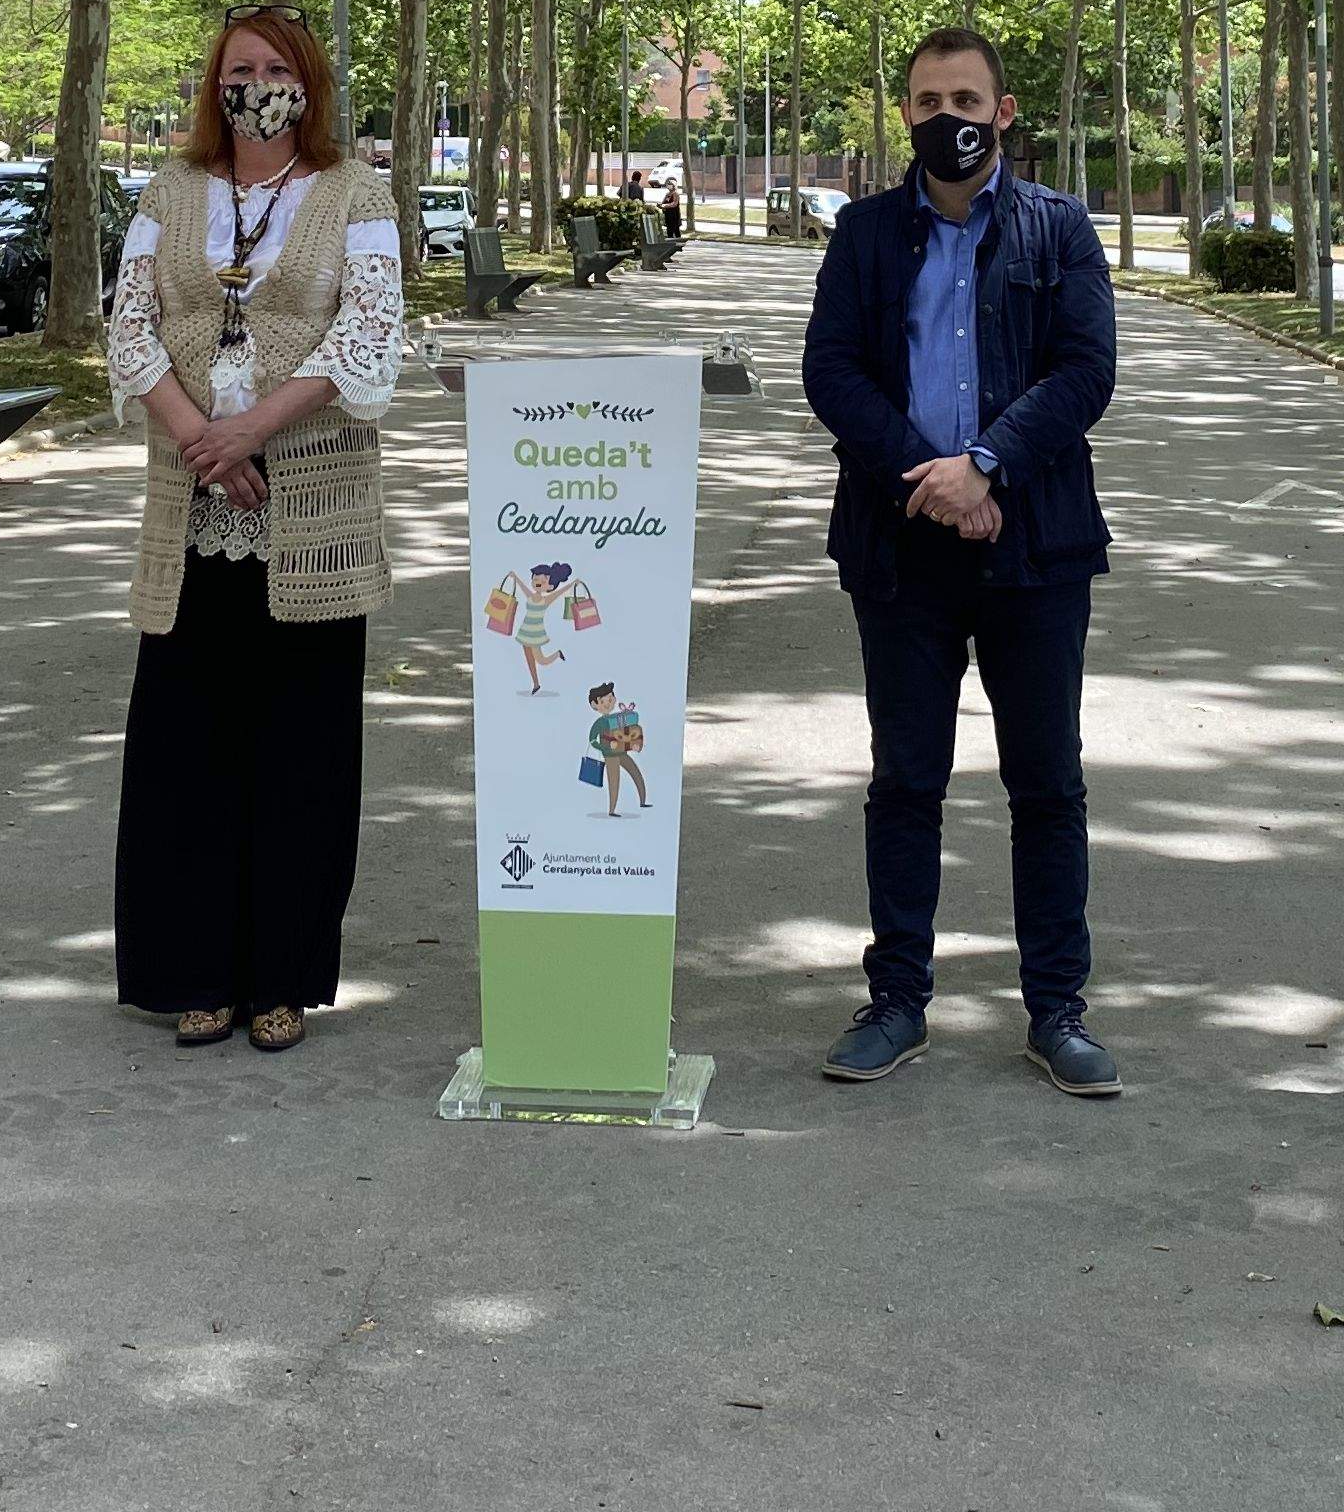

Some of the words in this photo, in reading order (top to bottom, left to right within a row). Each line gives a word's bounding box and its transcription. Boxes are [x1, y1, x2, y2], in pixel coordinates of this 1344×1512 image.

[513, 438, 652, 468] Queda't
[546, 474, 618, 500] amb
[497, 501, 667, 549] Cerdanyola
[542, 852, 601, 864] Ajuntament
[603, 854, 617, 864] de
[542, 864, 602, 877] Cerdanyola
[604, 865, 622, 876] del
